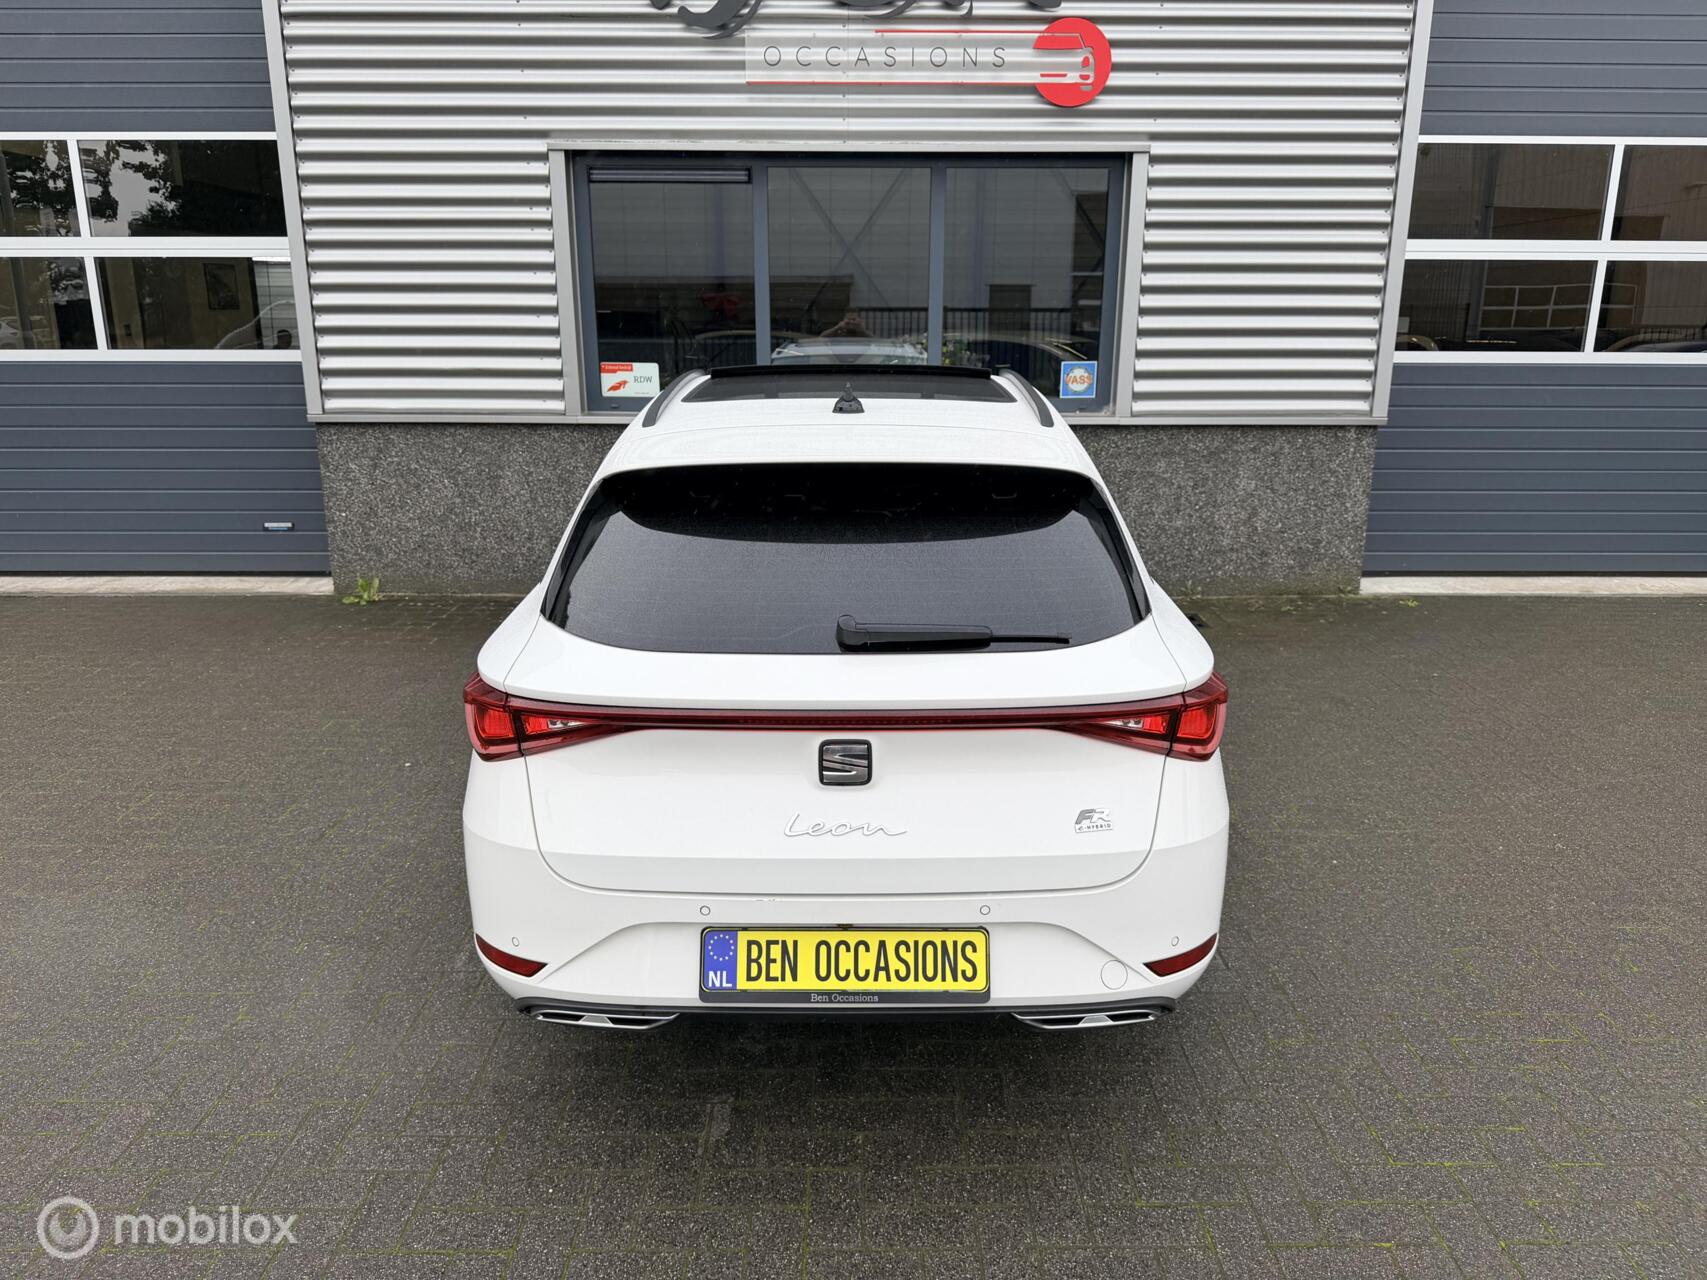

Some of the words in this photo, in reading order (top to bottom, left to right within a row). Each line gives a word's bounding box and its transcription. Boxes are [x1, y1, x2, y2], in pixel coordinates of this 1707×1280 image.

[763, 45, 1007, 69] OCCASIONS
[633, 375, 653, 384] RDW
[783, 811, 907, 837] Leon
[745, 939, 799, 983] BEN
[814, 939, 978, 983] OCCASIONS
[708, 970, 733, 988] NL
[810, 993, 829, 1003] Ben
[831, 993, 879, 1003] Occasions
